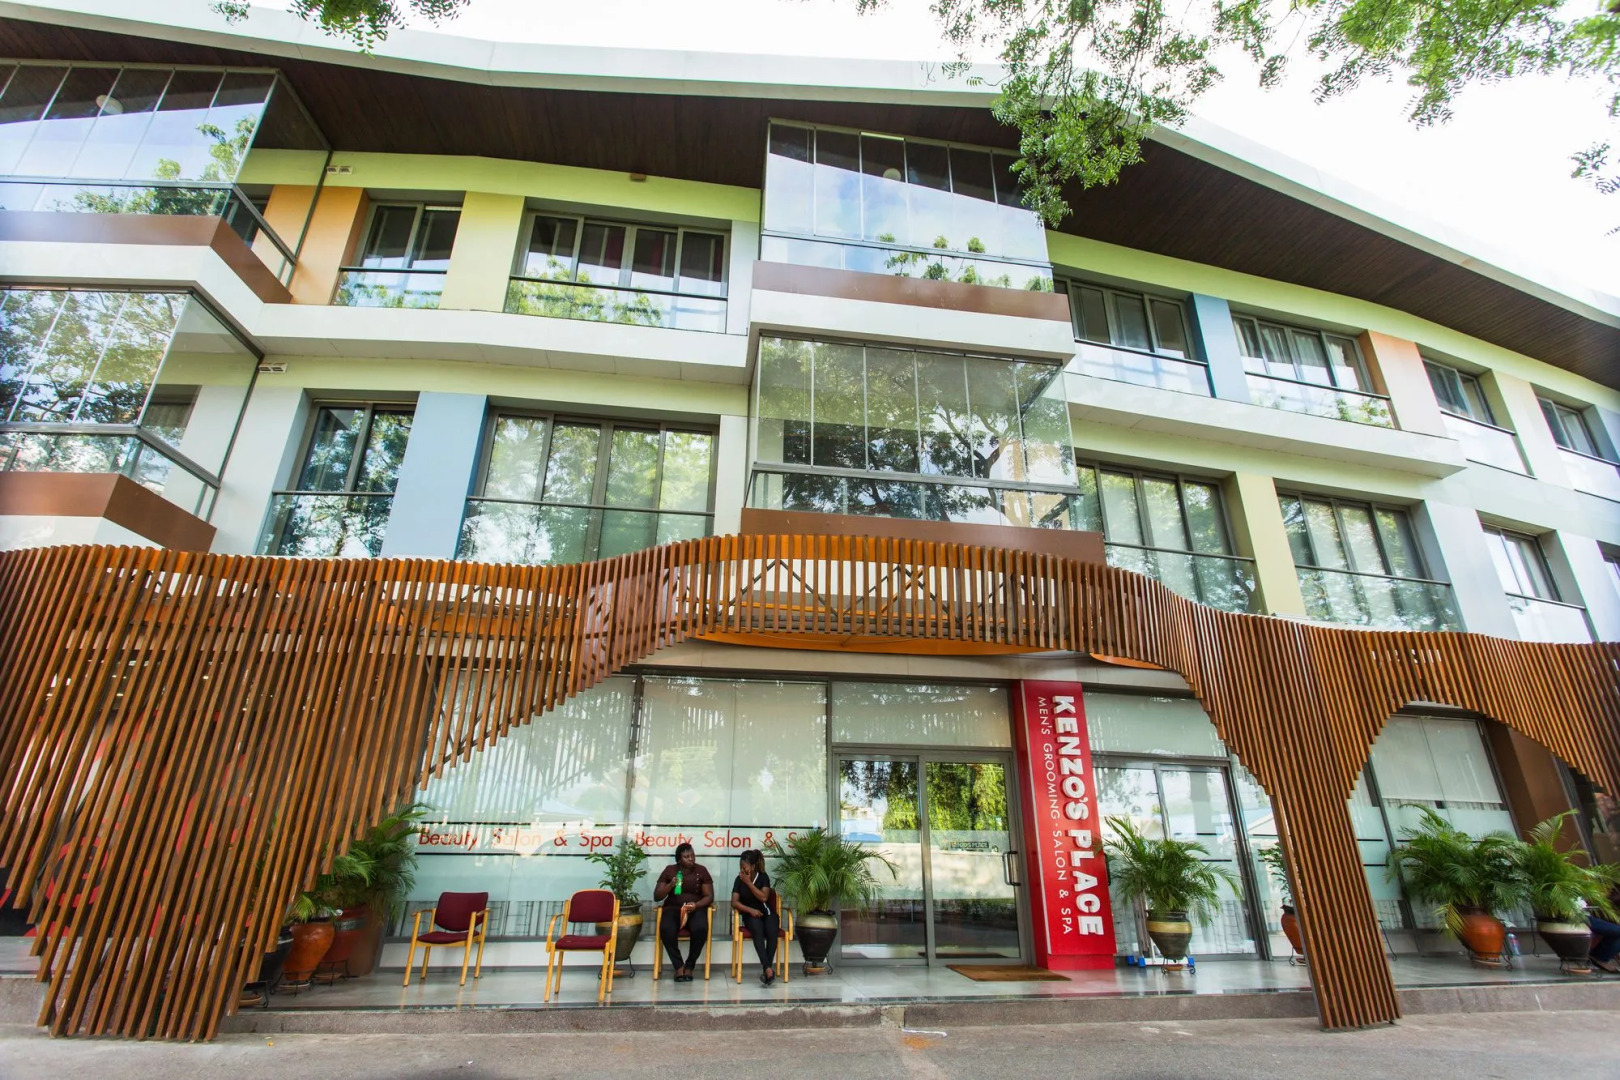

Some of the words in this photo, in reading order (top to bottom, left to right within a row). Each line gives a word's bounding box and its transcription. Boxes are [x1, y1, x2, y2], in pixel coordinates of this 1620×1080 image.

[1038, 696, 1052, 735] MEN'S
[1052, 695, 1089, 820] KENZO'S
[1043, 743, 1060, 820] GROOMING
[418, 827, 477, 851] Beauty
[491, 827, 542, 848] Salon
[554, 828, 567, 847] &
[579, 828, 613, 852] Spa
[704, 829, 752, 848] Salon
[764, 831, 776, 848] &
[1053, 830, 1067, 880] SALON
[1059, 889, 1069, 898] &
[1068, 829, 1104, 935] PLACE
[1061, 907, 1072, 934] SPA
